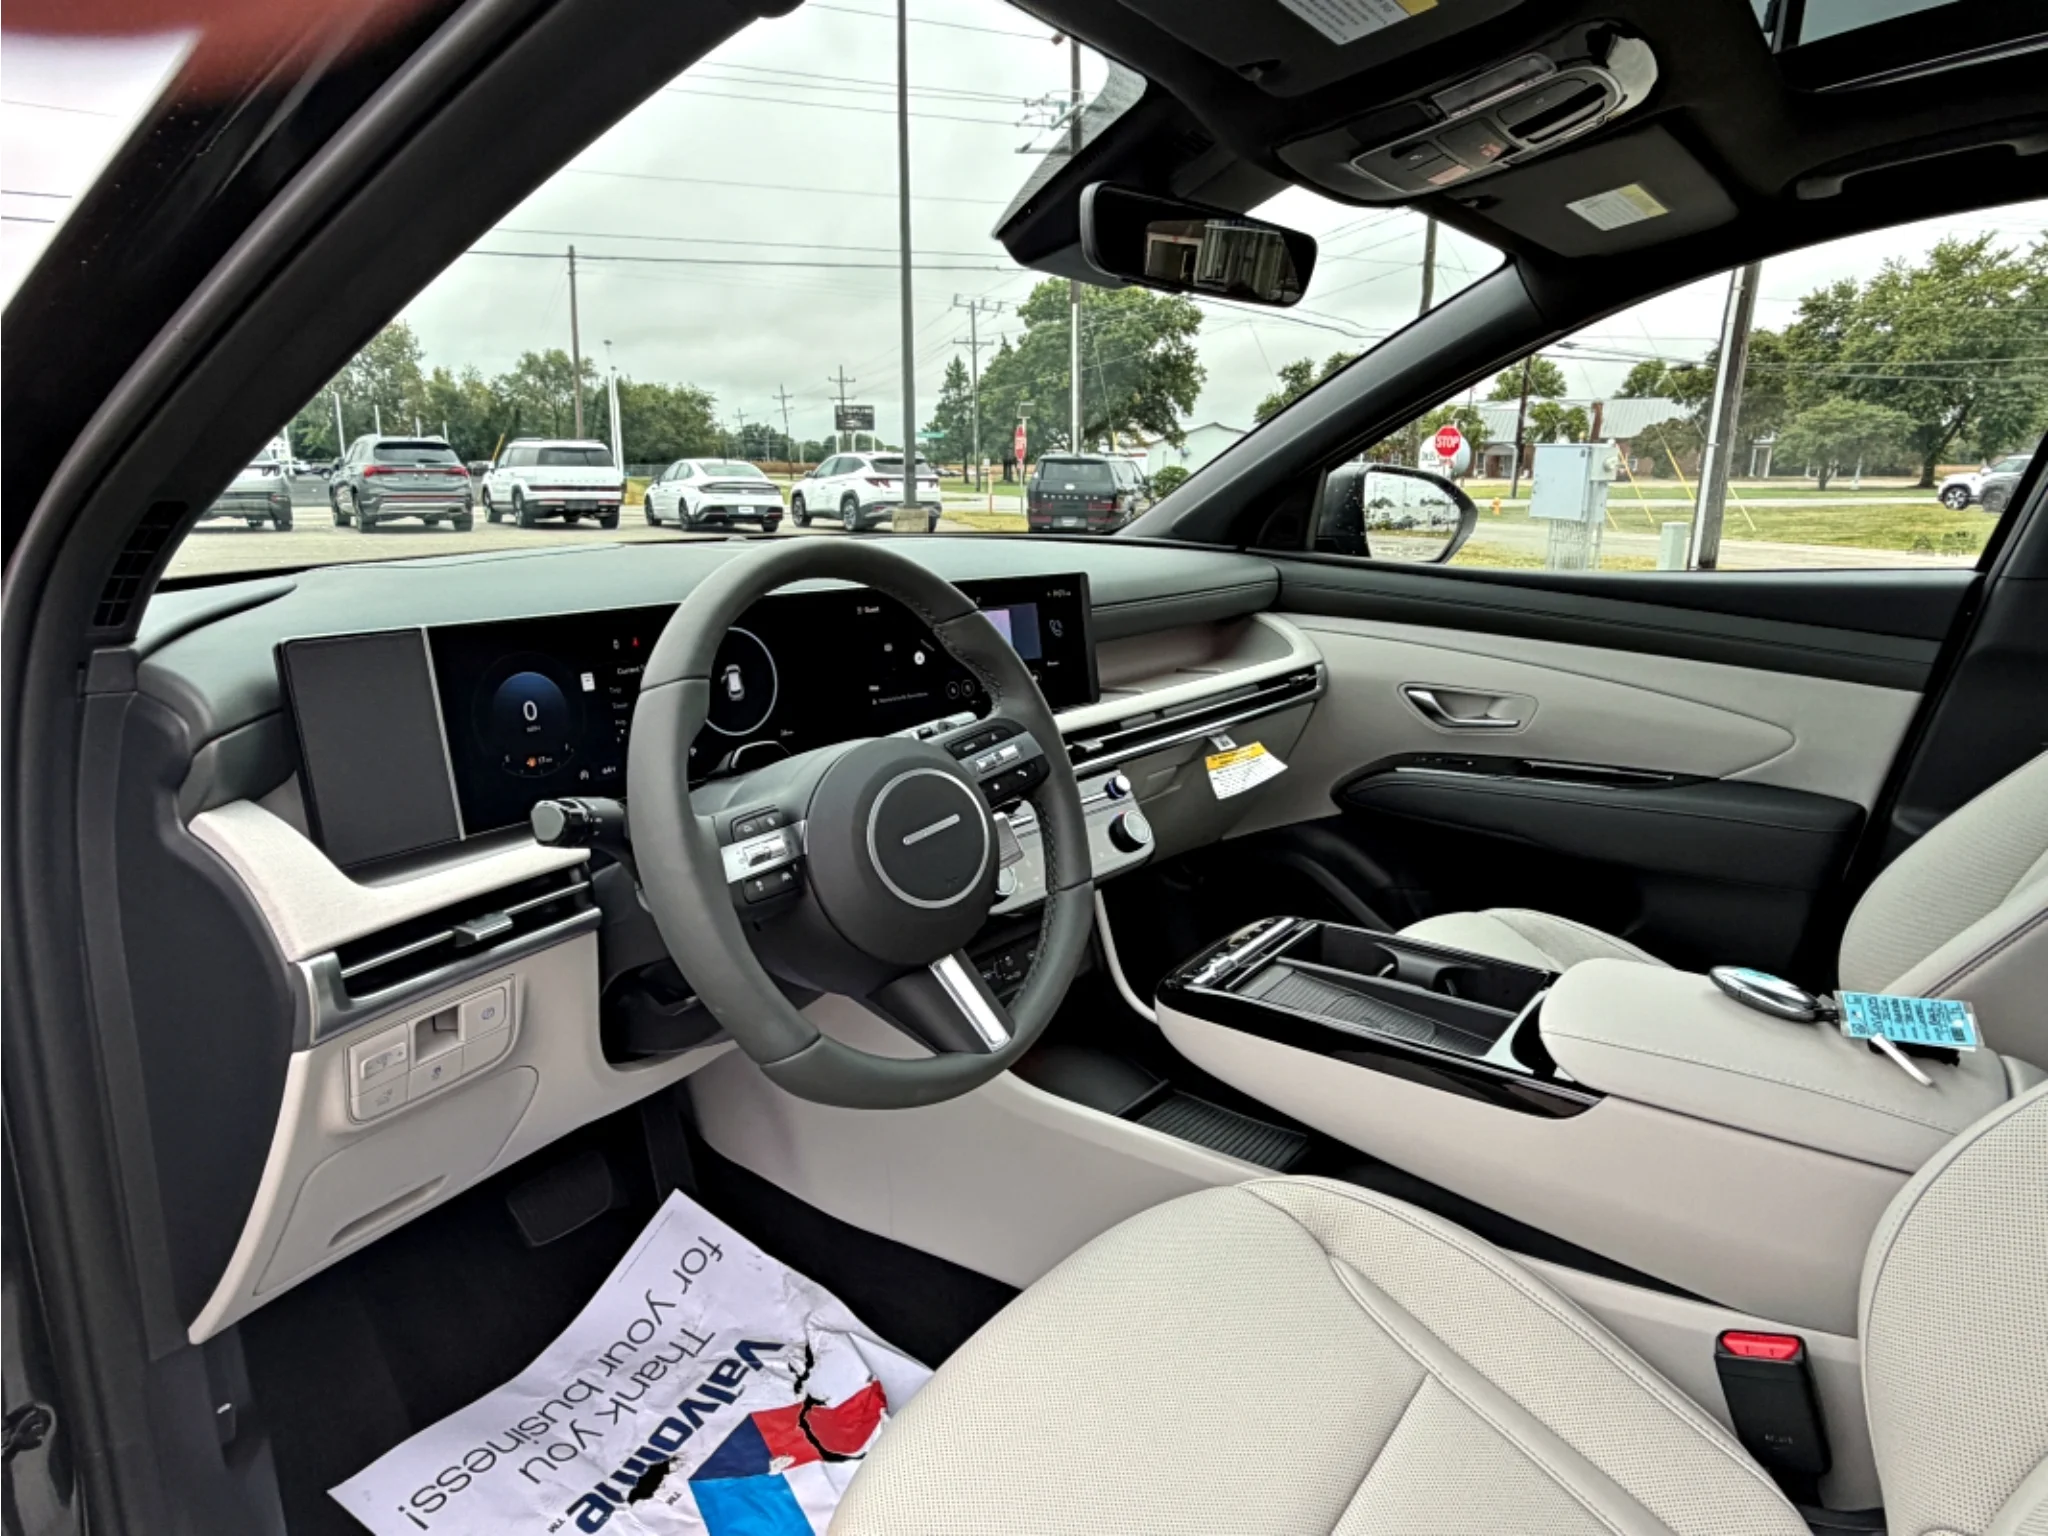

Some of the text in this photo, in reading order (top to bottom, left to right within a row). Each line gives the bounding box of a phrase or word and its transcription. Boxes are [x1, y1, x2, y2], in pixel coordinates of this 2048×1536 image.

[1436, 435, 1460, 449] STOP
[523, 700, 538, 721] 0
[672, 1236, 724, 1294] for
[598, 1288, 677, 1377] your
[518, 1328, 716, 1485] Thank you
[397, 1378, 605, 1531] business!
